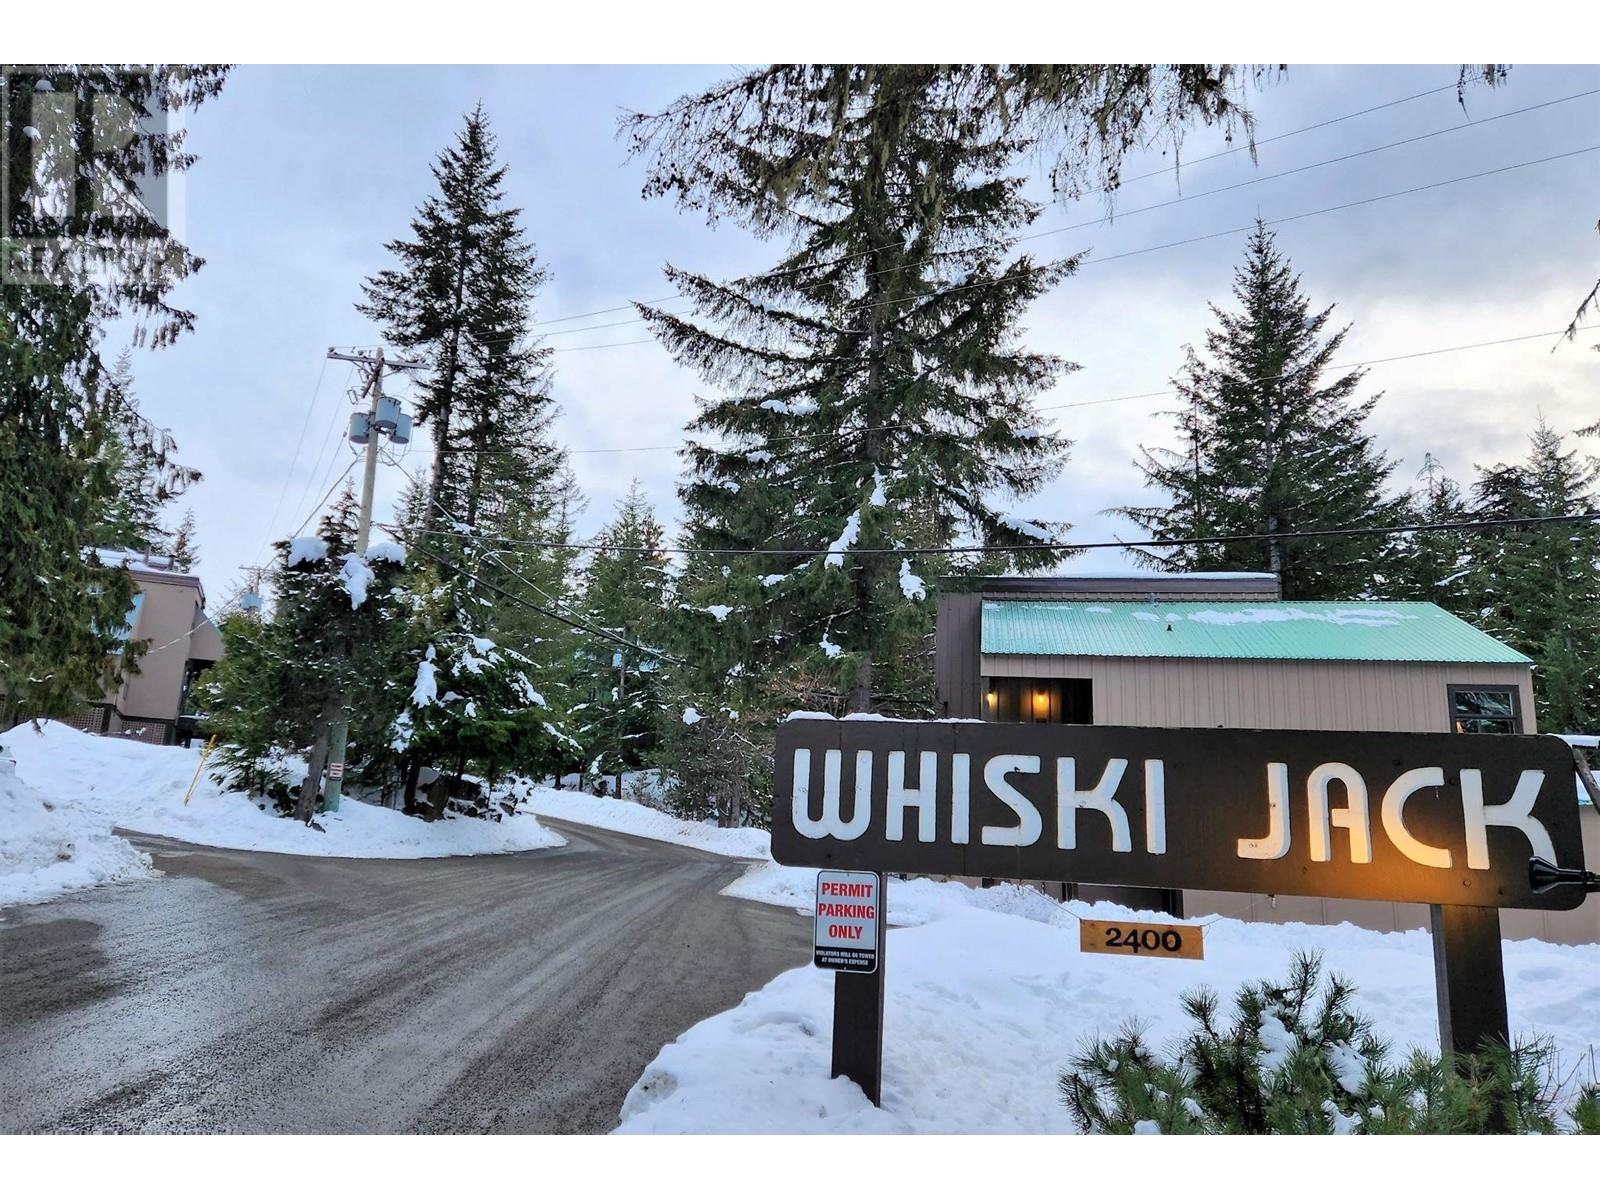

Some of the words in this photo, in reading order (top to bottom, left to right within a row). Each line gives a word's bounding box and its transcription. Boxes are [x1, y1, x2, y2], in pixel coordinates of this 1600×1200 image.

[792, 747, 1167, 855] WHISKI
[1237, 761, 1558, 871] JACK
[822, 883, 873, 897] PERMIT
[818, 903, 875, 919] PARKING
[828, 924, 863, 939] ONLY
[1105, 927, 1182, 953] 2400
